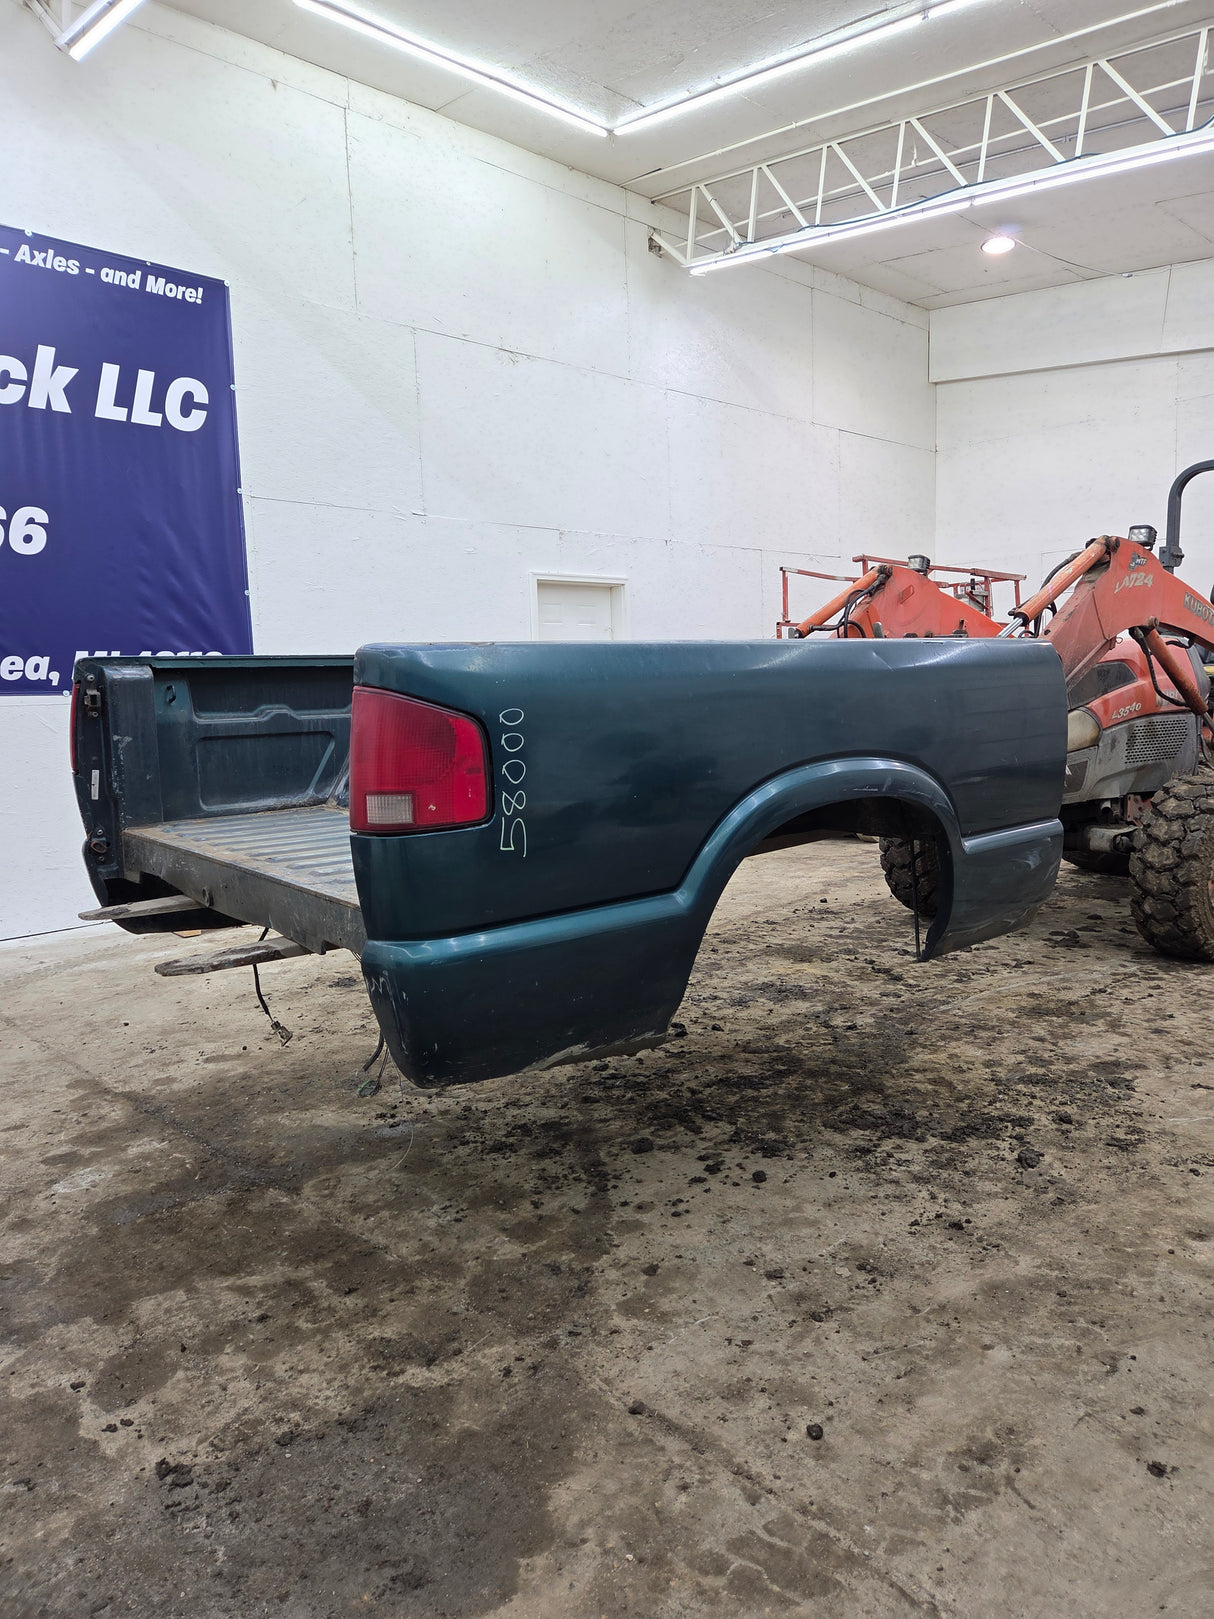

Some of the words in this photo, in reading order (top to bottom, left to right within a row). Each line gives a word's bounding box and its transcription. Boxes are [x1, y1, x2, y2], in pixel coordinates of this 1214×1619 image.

[14, 244, 80, 275] Axles
[85, 266, 95, 275] -
[100, 267, 141, 290] and
[145, 275, 204, 305] More!
[94, 362, 210, 432] LLC
[0, 505, 49, 556] 6
[1113, 572, 1154, 594] LA724
[1111, 702, 1142, 720] L3540
[499, 708, 527, 858] 58000
